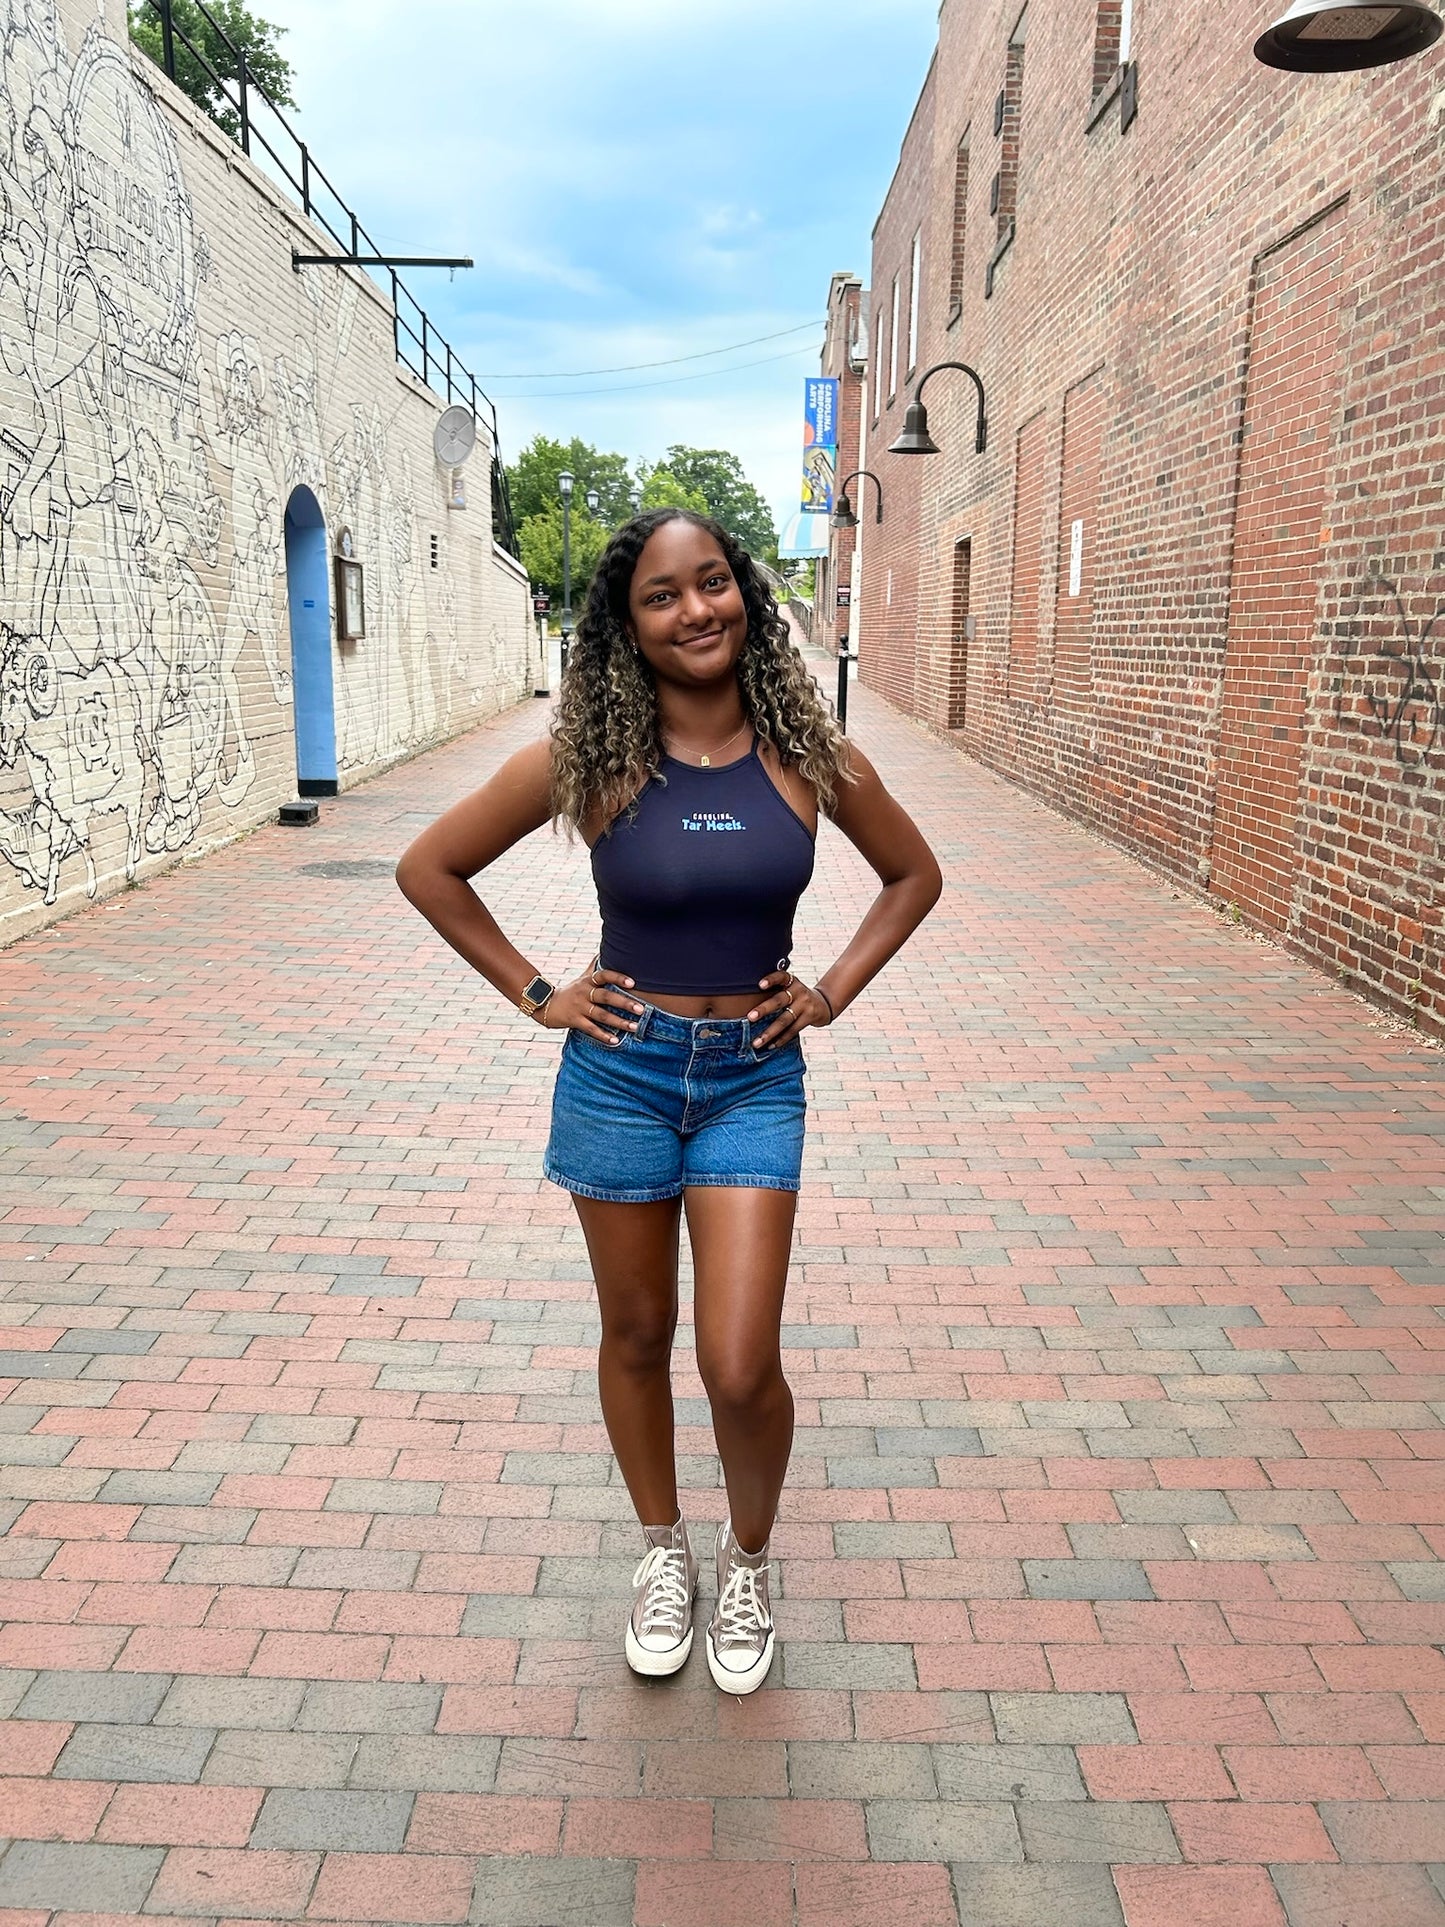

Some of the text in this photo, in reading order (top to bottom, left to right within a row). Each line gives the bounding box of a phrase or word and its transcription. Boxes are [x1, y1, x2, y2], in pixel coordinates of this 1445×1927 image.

[809, 383, 817, 409] ARTS
[815, 383, 824, 443] PERFORMING
[823, 383, 832, 432] CAROLINA
[681, 819, 746, 831] Tar Heels.
